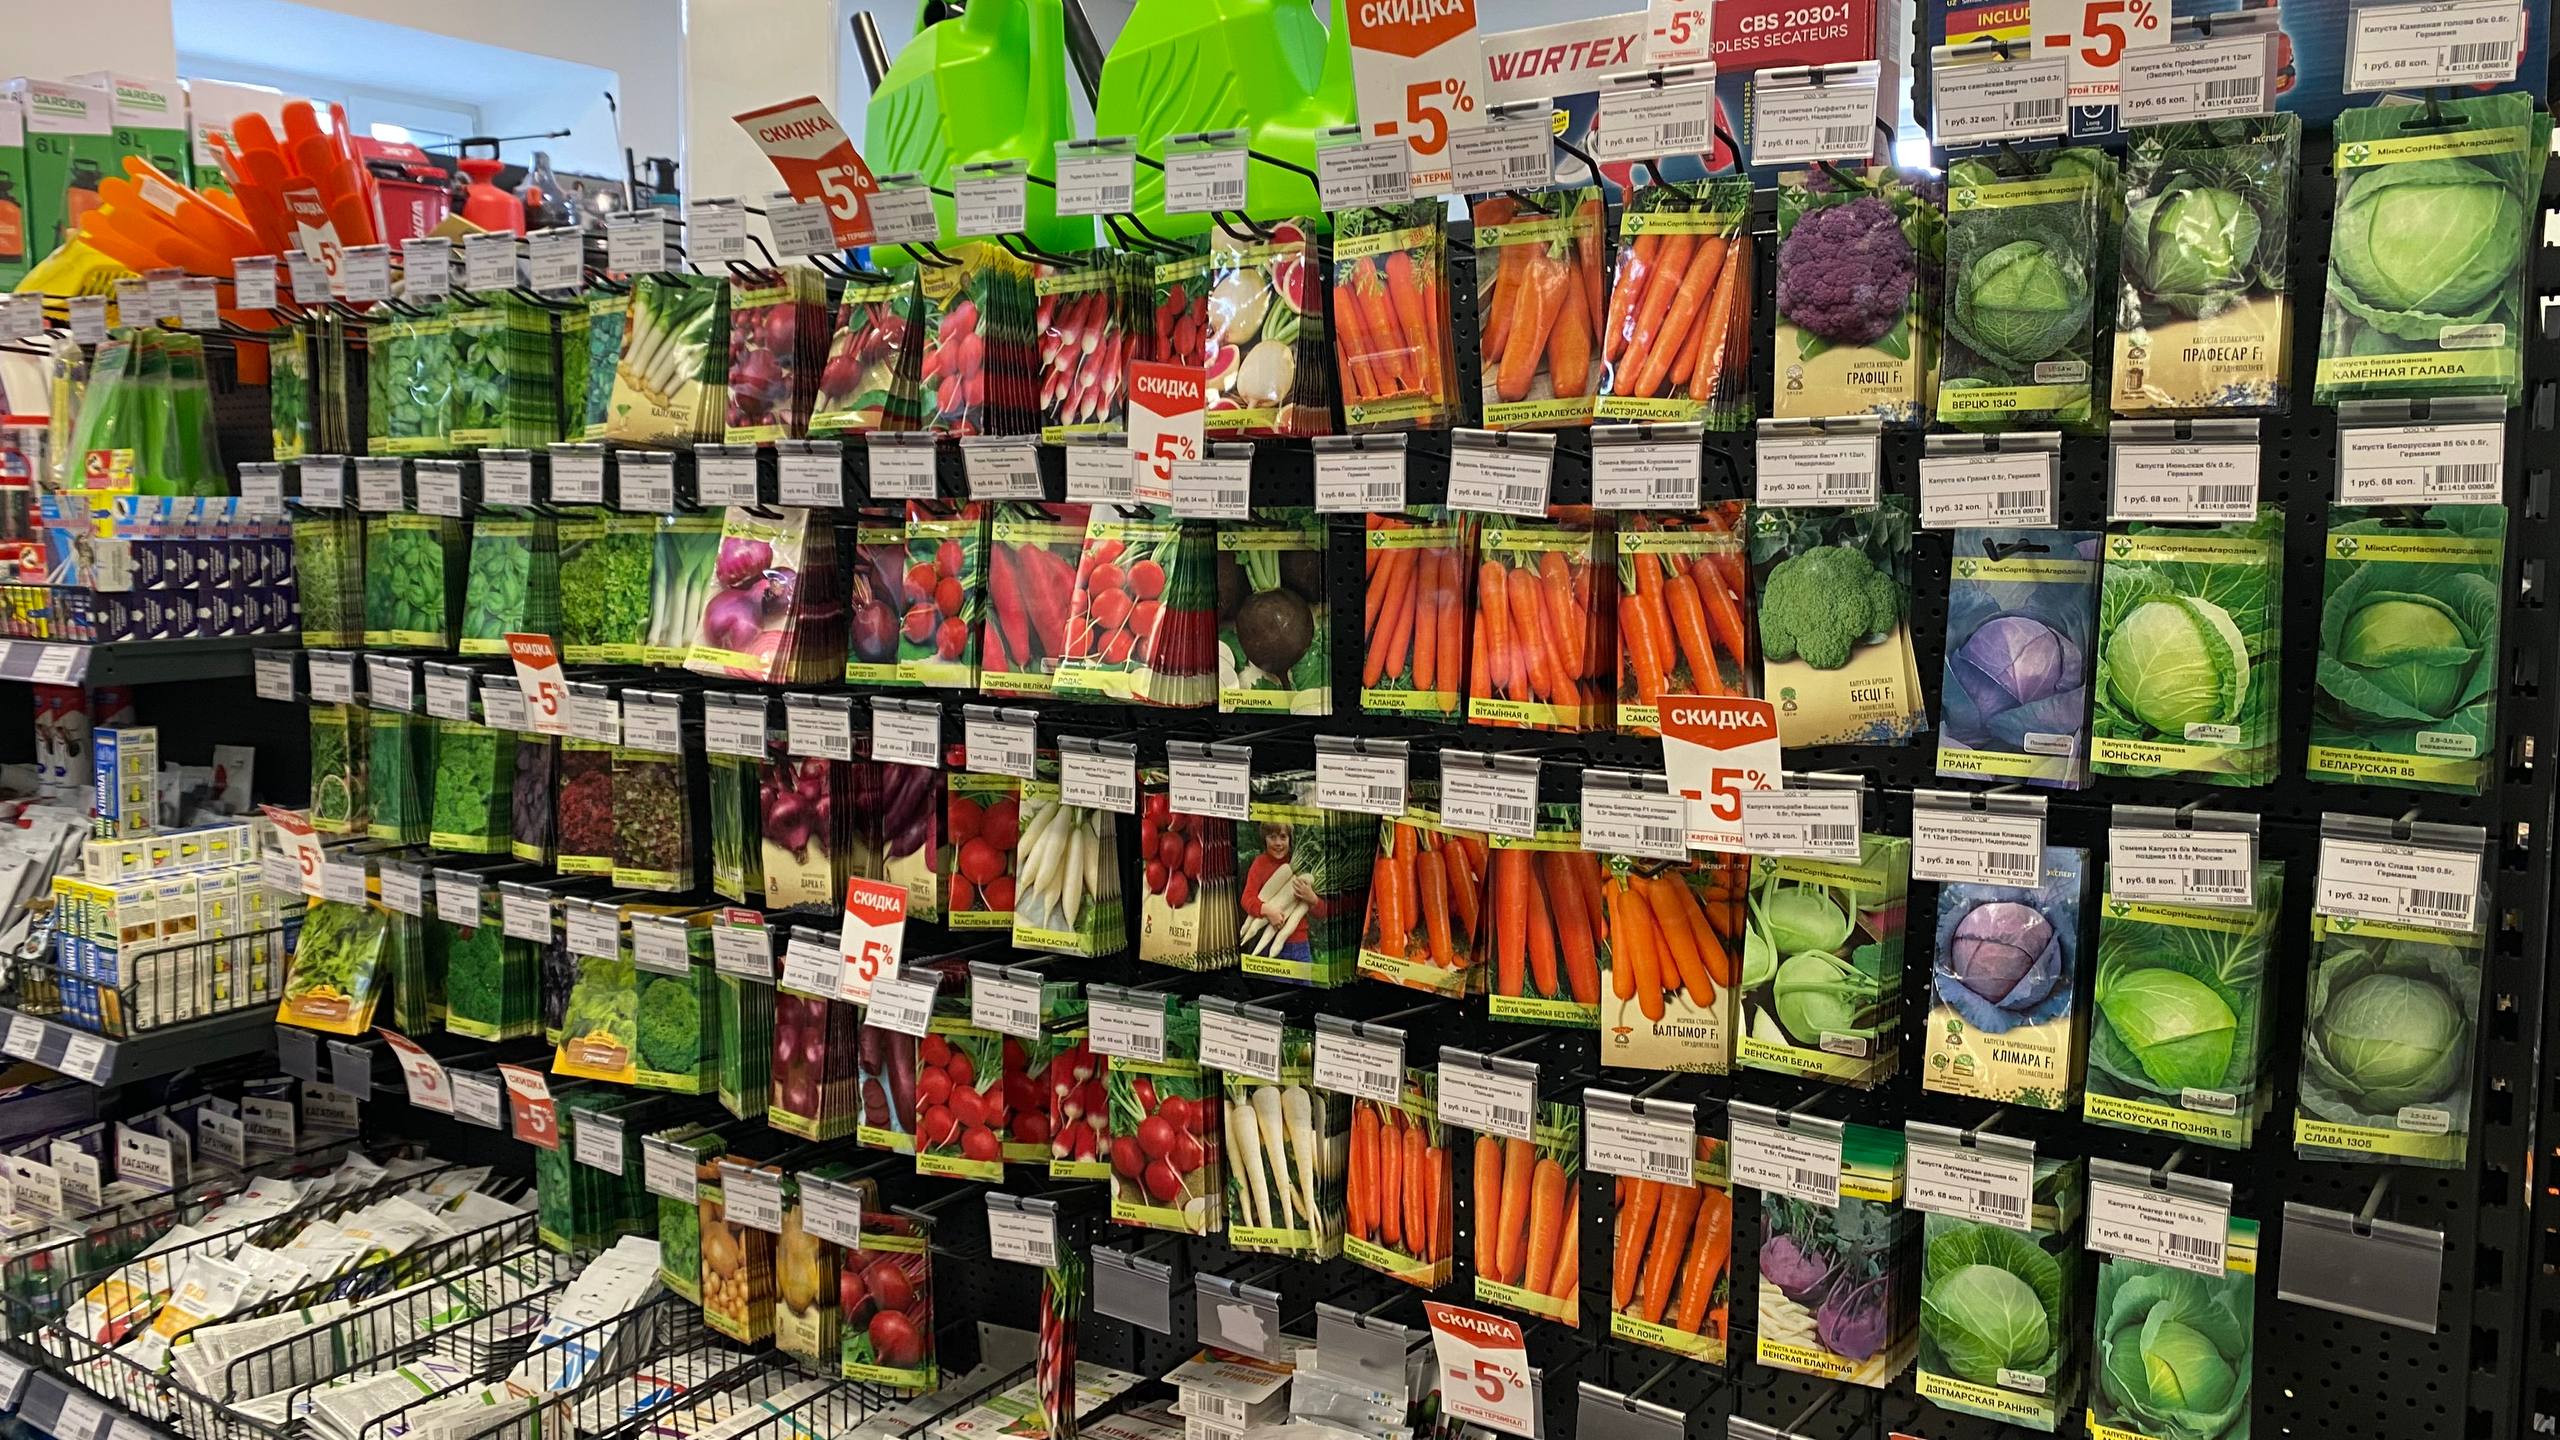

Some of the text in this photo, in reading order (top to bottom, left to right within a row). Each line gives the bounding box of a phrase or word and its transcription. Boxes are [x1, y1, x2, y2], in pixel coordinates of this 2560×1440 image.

[1361, 0, 1464, 27] СКИДКА
[1740, 3, 1850, 34] CBS 2030-1
[1654, 11, 1705, 44] -5%
[2364, 25, 2398, 34] Капуста
[2415, 29, 2457, 39] Германия
[1763, 24, 1848, 48] SECATEURS
[1488, 34, 1638, 81] WORTEX
[2364, 58, 2430, 72] 1 руб. 68 коп.
[32, 94, 86, 110] GARDEN
[116, 87, 166, 103] GARDEN
[1374, 78, 1474, 155] -5%
[1951, 117, 1968, 126] руб.
[1981, 115, 1998, 124] коп.
[759, 116, 834, 143] СКИДКА
[2183, 347, 2248, 363] ПРАФЕСАР
[1847, 370, 1889, 385] ГРАФІЦІ
[2333, 365, 2465, 380] КАМЕННАЯ ГАЛАВА
[1137, 376, 1199, 399] СКИДКА
[1600, 406, 1681, 418] АМСТЭРДАМСКАЯ
[1952, 399, 2017, 409] ВЕРЦЮ 1340
[1488, 413, 1529, 422] ШАНТЭНЭ
[2399, 449, 2440, 458] Германия
[2136, 462, 2163, 470] Капуста
[2351, 477, 2415, 488] 1 руб. 68 коп.
[2124, 495, 2127, 503] 1
[2130, 495, 2148, 505] руб.
[2163, 496, 2180, 504] коп.
[1935, 505, 1952, 514] руб.
[1966, 504, 1981, 512] коп.
[513, 642, 552, 657] СКИДКА
[1223, 697, 1273, 707] НЕГРЫЦЯНКА
[1850, 688, 1881, 703] БЕСЦІ
[1671, 708, 1768, 731] СКИДКА
[2101, 749, 2161, 763] ІЮНЬСКАЯ
[1943, 759, 1982, 771] ГРАНАТ
[2320, 759, 2415, 777] БЕЛАРУСКАЯ 85
[97, 768, 106, 816] КЛИМАТ
[1680, 768, 1773, 821] -5%
[2340, 856, 2372, 866] Капуста
[2388, 861, 2414, 872] Слава
[2126, 876, 2144, 885] руб.
[2158, 877, 2176, 885] коп.
[2377, 870, 2417, 879] Германия
[853, 890, 900, 912] СКИДКА
[2328, 889, 2391, 904] 1 руб. 32 коп.
[844, 940, 893, 982] -5%
[1364, 958, 1400, 974] САМСОН
[1652, 1022, 1708, 1039] БАЛТЫМОР
[1744, 1048, 1823, 1071] ВЕНСКАЯ БЕЛАЯ
[1992, 1048, 2041, 1067] КЛІМАРА
[508, 1074, 544, 1091] СКИДКА
[2171, 1120, 2219, 1137] ПОЗНЯЯ
[2221, 1128, 2232, 1139] 15
[2304, 1132, 2372, 1149] СЛАВА 1305
[121, 1155, 160, 1176] КАГАТНИК
[1920, 1188, 1936, 1198] руб.
[1938, 1191, 1947, 1199] 68
[1948, 1194, 1964, 1202] коп.
[1116, 1210, 1137, 1220] ЖАРА
[2098, 1227, 2152, 1245] 1 руб. 68 коп.
[1478, 1287, 1513, 1302] КАРЛЕНА
[1437, 1311, 1516, 1341] СКИДКА
[1637, 1328, 1665, 1344] ЛОНГА
[1762, 1349, 1801, 1366] ВЕНСКАЯ
[1449, 1359, 1524, 1403] -5%
[1925, 1383, 2041, 1418] ДЗІТМАРСКАЯ РАННЯЯ
